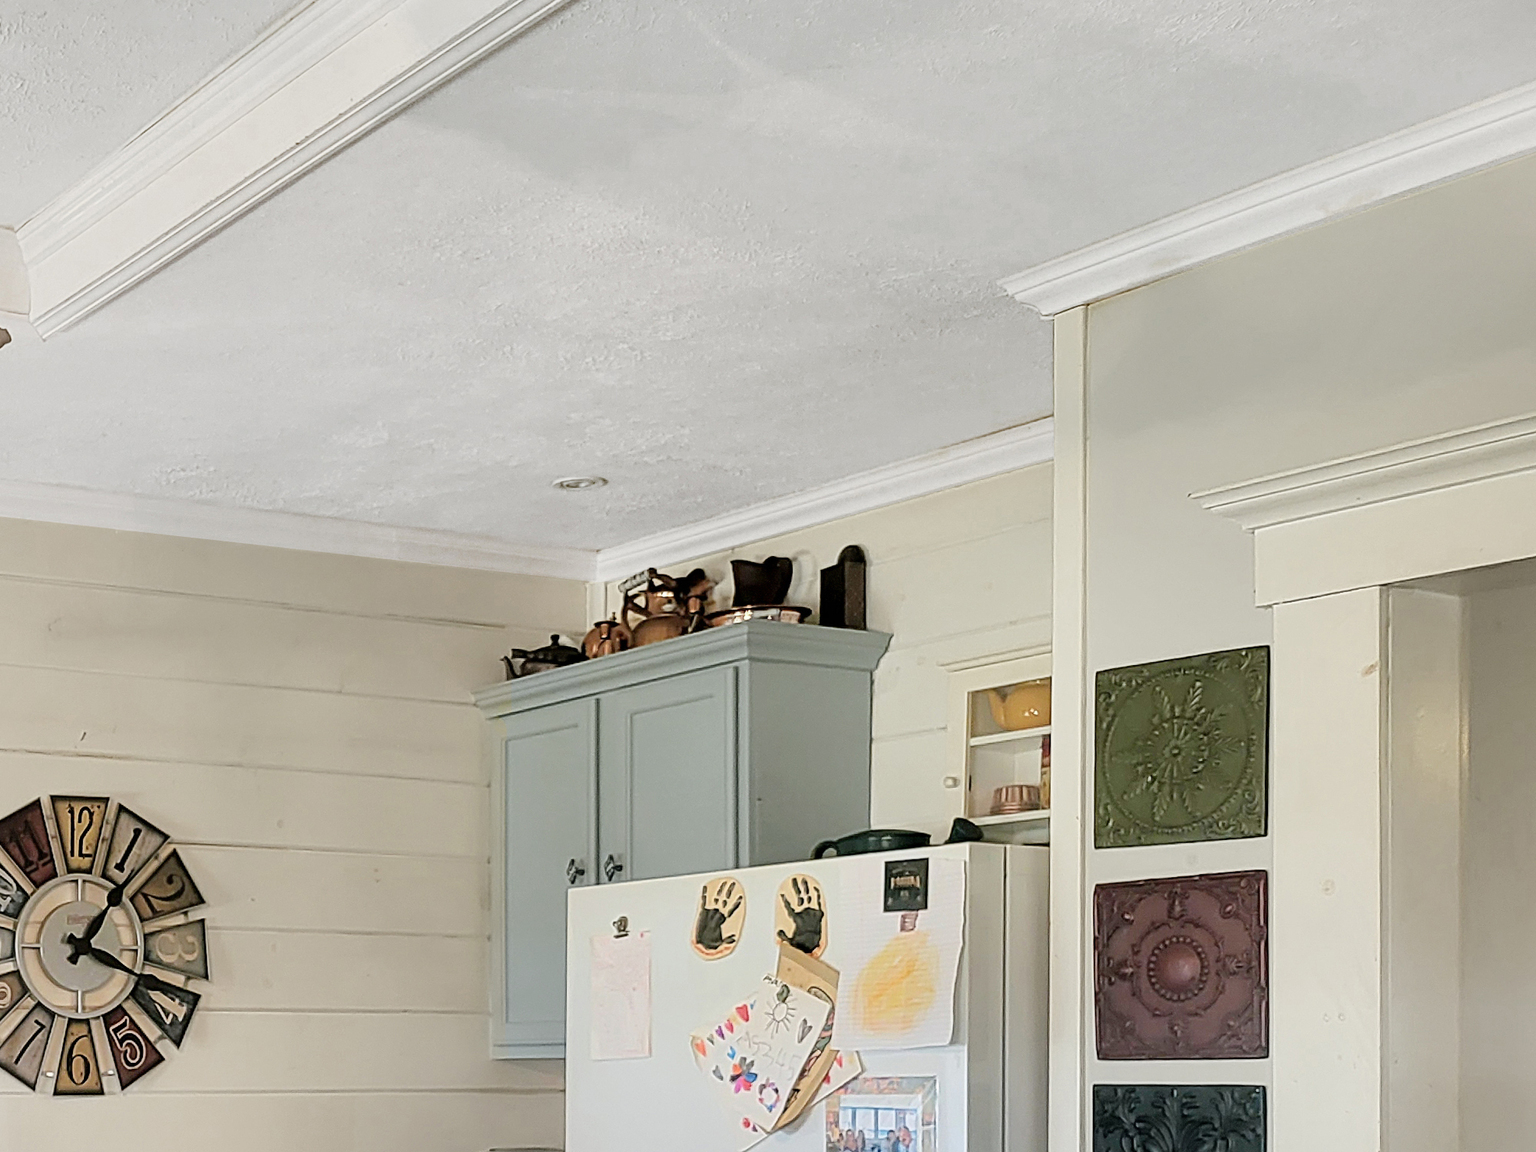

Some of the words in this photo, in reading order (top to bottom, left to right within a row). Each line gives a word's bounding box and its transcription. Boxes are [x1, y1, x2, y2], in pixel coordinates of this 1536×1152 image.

[8, 819, 52, 875] 11
[67, 805, 95, 859] 12
[113, 827, 143, 874] 1
[139, 873, 186, 918] 2
[155, 933, 199, 963] 3
[147, 990, 187, 1025] 4
[14, 1019, 47, 1066] 7
[66, 1034, 91, 1086] 6
[109, 1015, 147, 1071] 5
